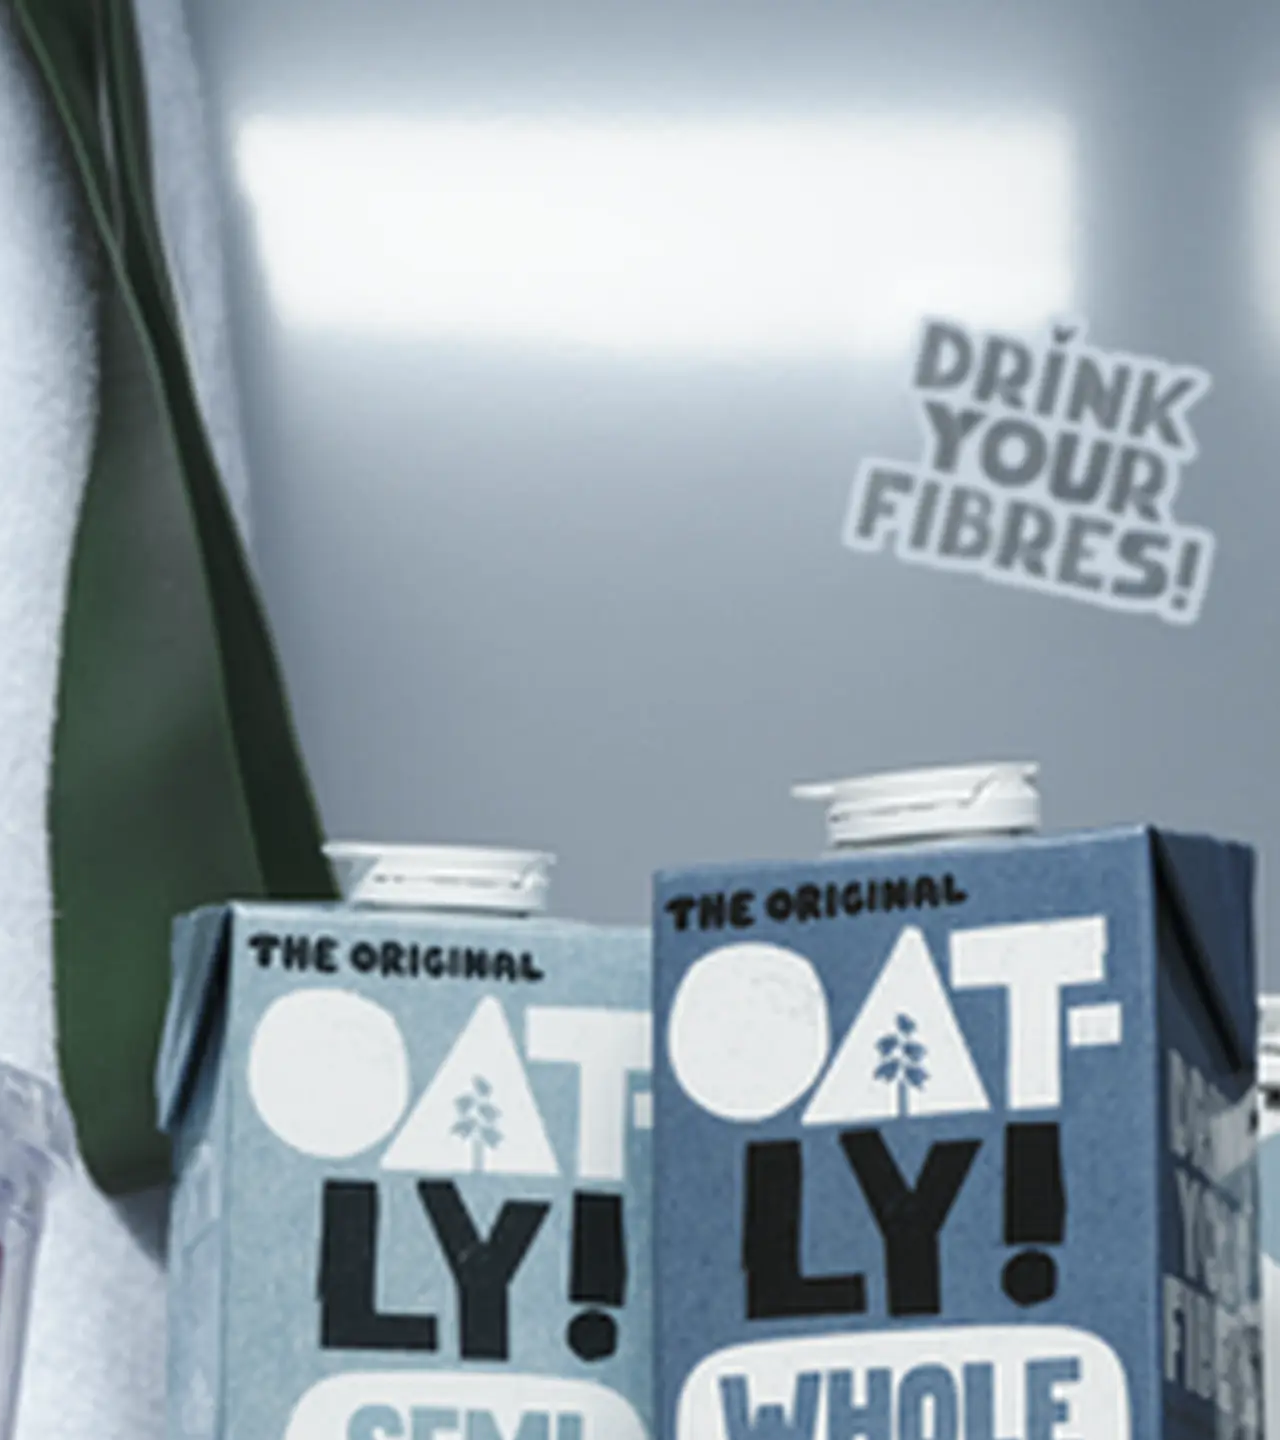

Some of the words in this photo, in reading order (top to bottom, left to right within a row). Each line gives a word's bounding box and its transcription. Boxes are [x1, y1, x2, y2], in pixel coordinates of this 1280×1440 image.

[922, 400, 1168, 522] YOUR
[854, 466, 1202, 612] FIBRES!
[248, 933, 340, 973] THE
[350, 941, 545, 983] ORIGINAL
[665, 891, 756, 931] THE
[765, 874, 968, 922] ORIGINAL
[319, 1178, 627, 1363] LY!
[743, 1121, 1067, 1320] LY!
